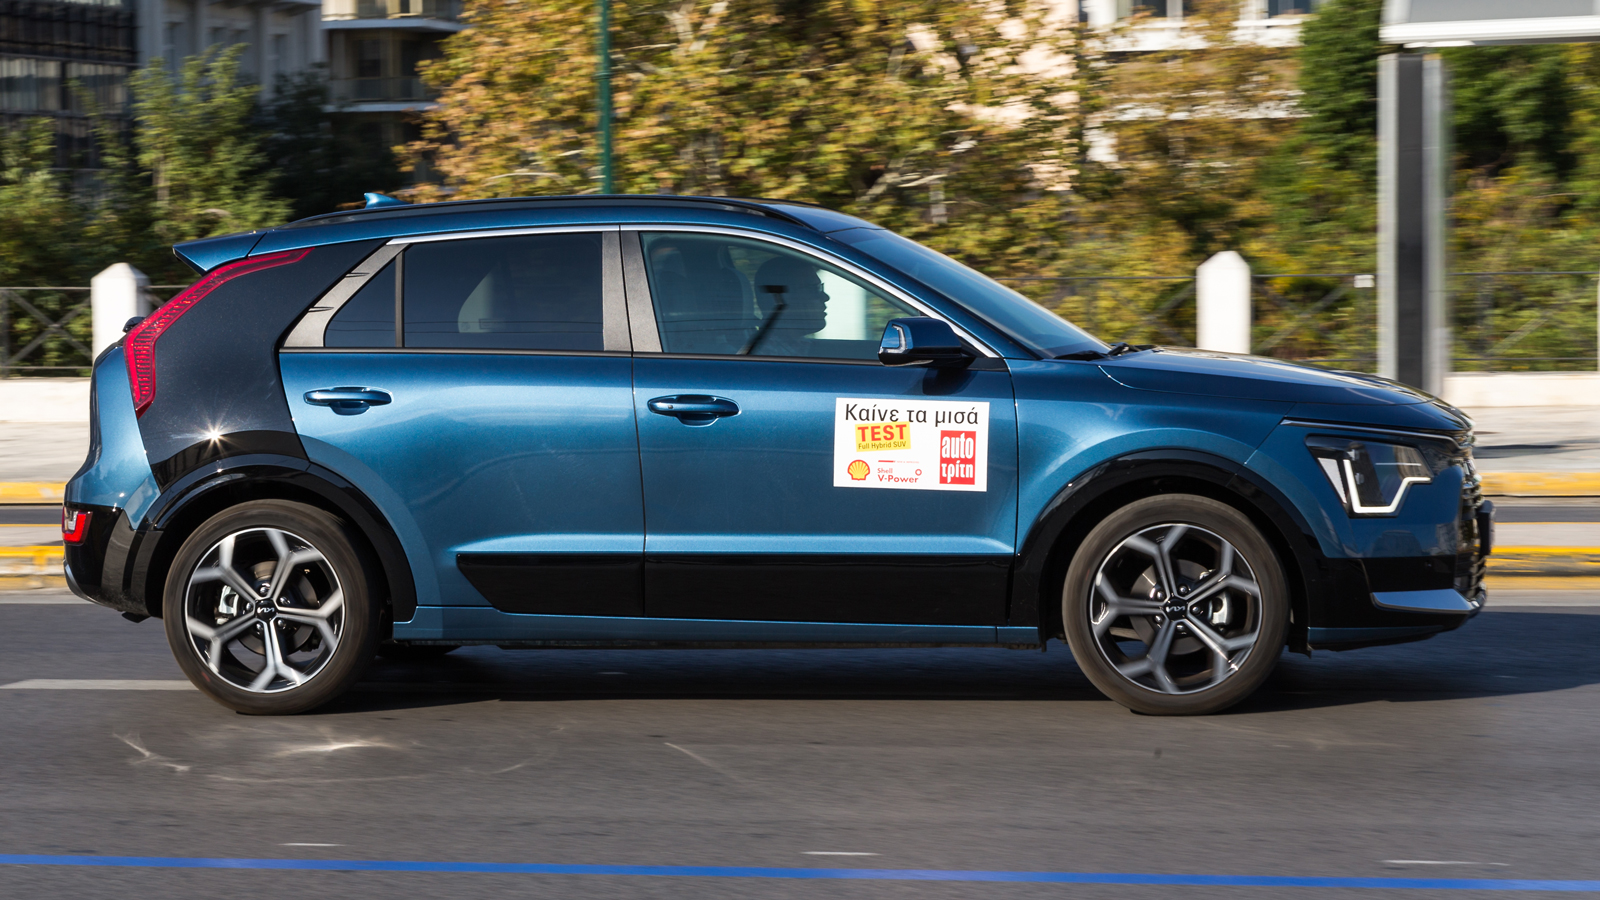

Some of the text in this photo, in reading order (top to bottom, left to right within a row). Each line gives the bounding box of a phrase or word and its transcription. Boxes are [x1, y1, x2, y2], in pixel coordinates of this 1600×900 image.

[845, 403, 978, 427] Καίνε τα μισά
[857, 424, 907, 442] TEST
[871, 442, 892, 450] Hybrid
[941, 432, 974, 459] auto
[877, 474, 919, 483] V-Power
